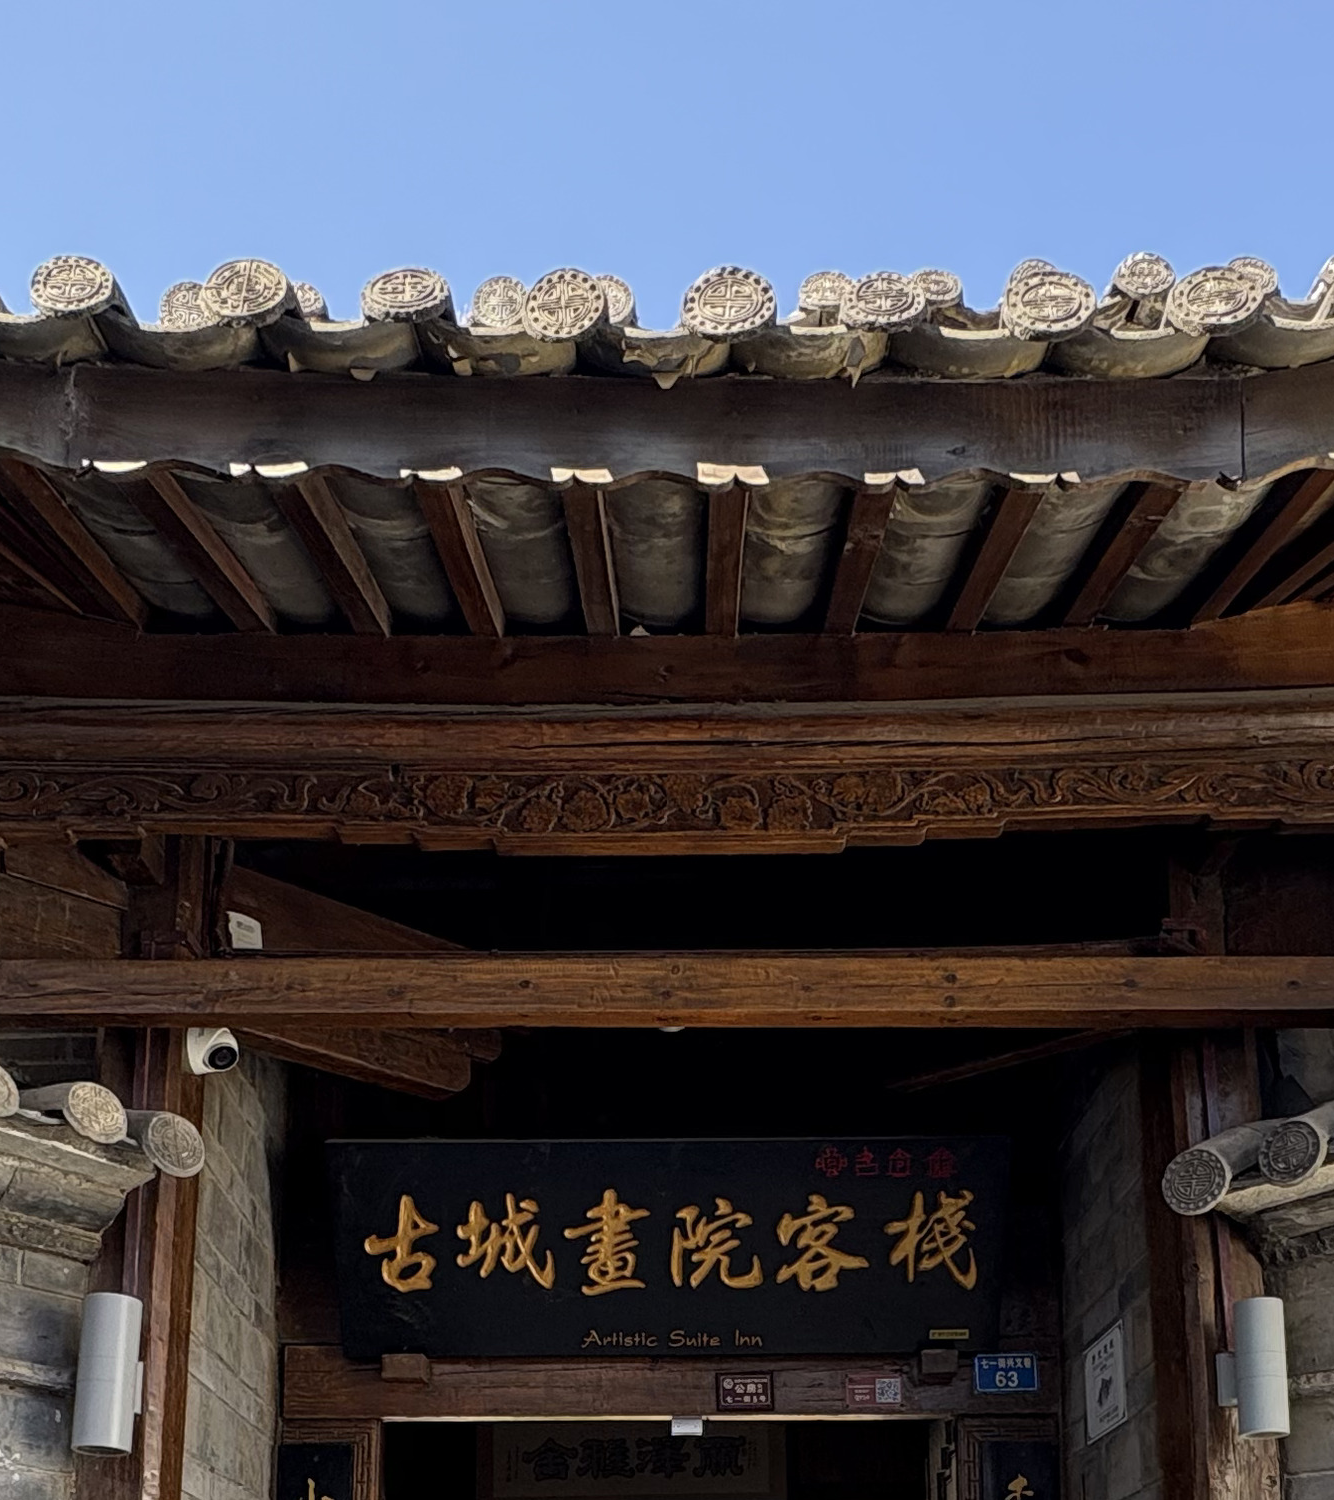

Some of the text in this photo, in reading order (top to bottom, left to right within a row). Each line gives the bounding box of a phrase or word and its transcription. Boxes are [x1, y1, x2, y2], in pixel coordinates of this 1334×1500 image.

[365, 1188, 977, 1295] 古城畫院客棧
[581, 1329, 763, 1348] Artistic Suite Inn
[995, 1370, 1019, 1388] 63
